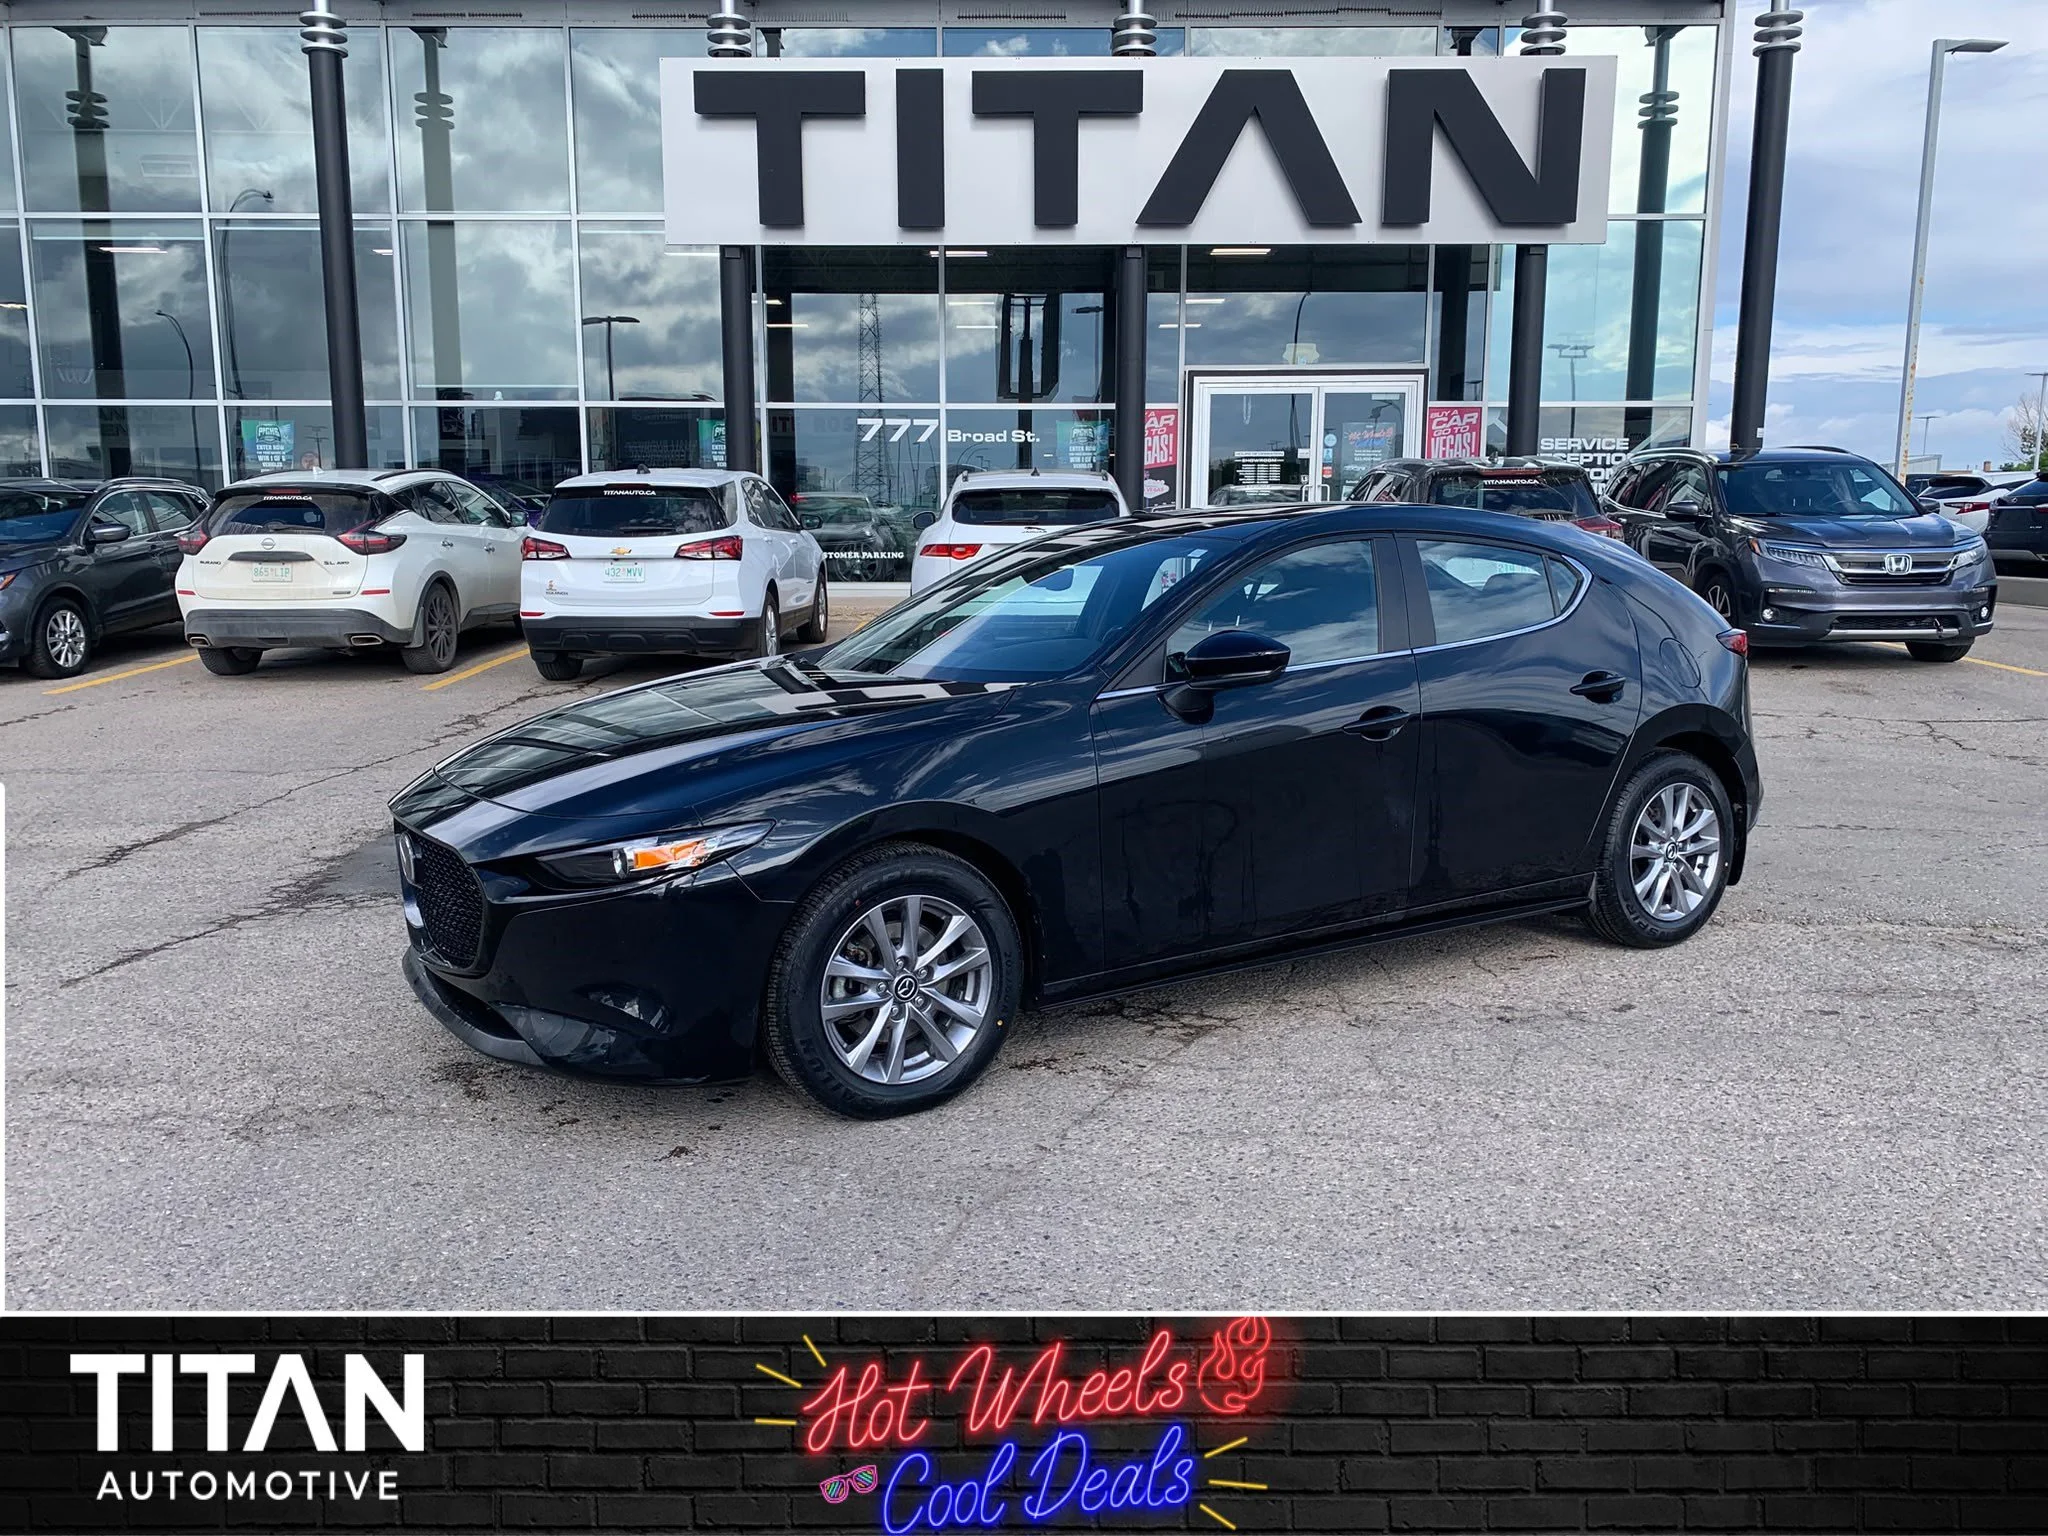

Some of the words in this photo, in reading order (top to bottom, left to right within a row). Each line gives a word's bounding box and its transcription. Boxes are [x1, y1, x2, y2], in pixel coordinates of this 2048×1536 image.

[693, 68, 1586, 228] TITAN
[1430, 410, 1451, 419] BUY
[1432, 412, 1479, 430] CAR
[856, 418, 939, 442] 777
[947, 429, 1007, 442] Broad
[1011, 429, 1040, 442] St.
[1150, 427, 1167, 436] TO
[1433, 428, 1451, 437] GO
[1453, 425, 1470, 434] TO
[1431, 431, 1477, 459] VEGAS!
[1540, 437, 1630, 451] SERVICE
[861, 551, 904, 559] PARKING
[253, 567, 269, 577] 865
[274, 567, 290, 577] LIP
[604, 567, 621, 577] 432
[626, 567, 643, 577] MVV
